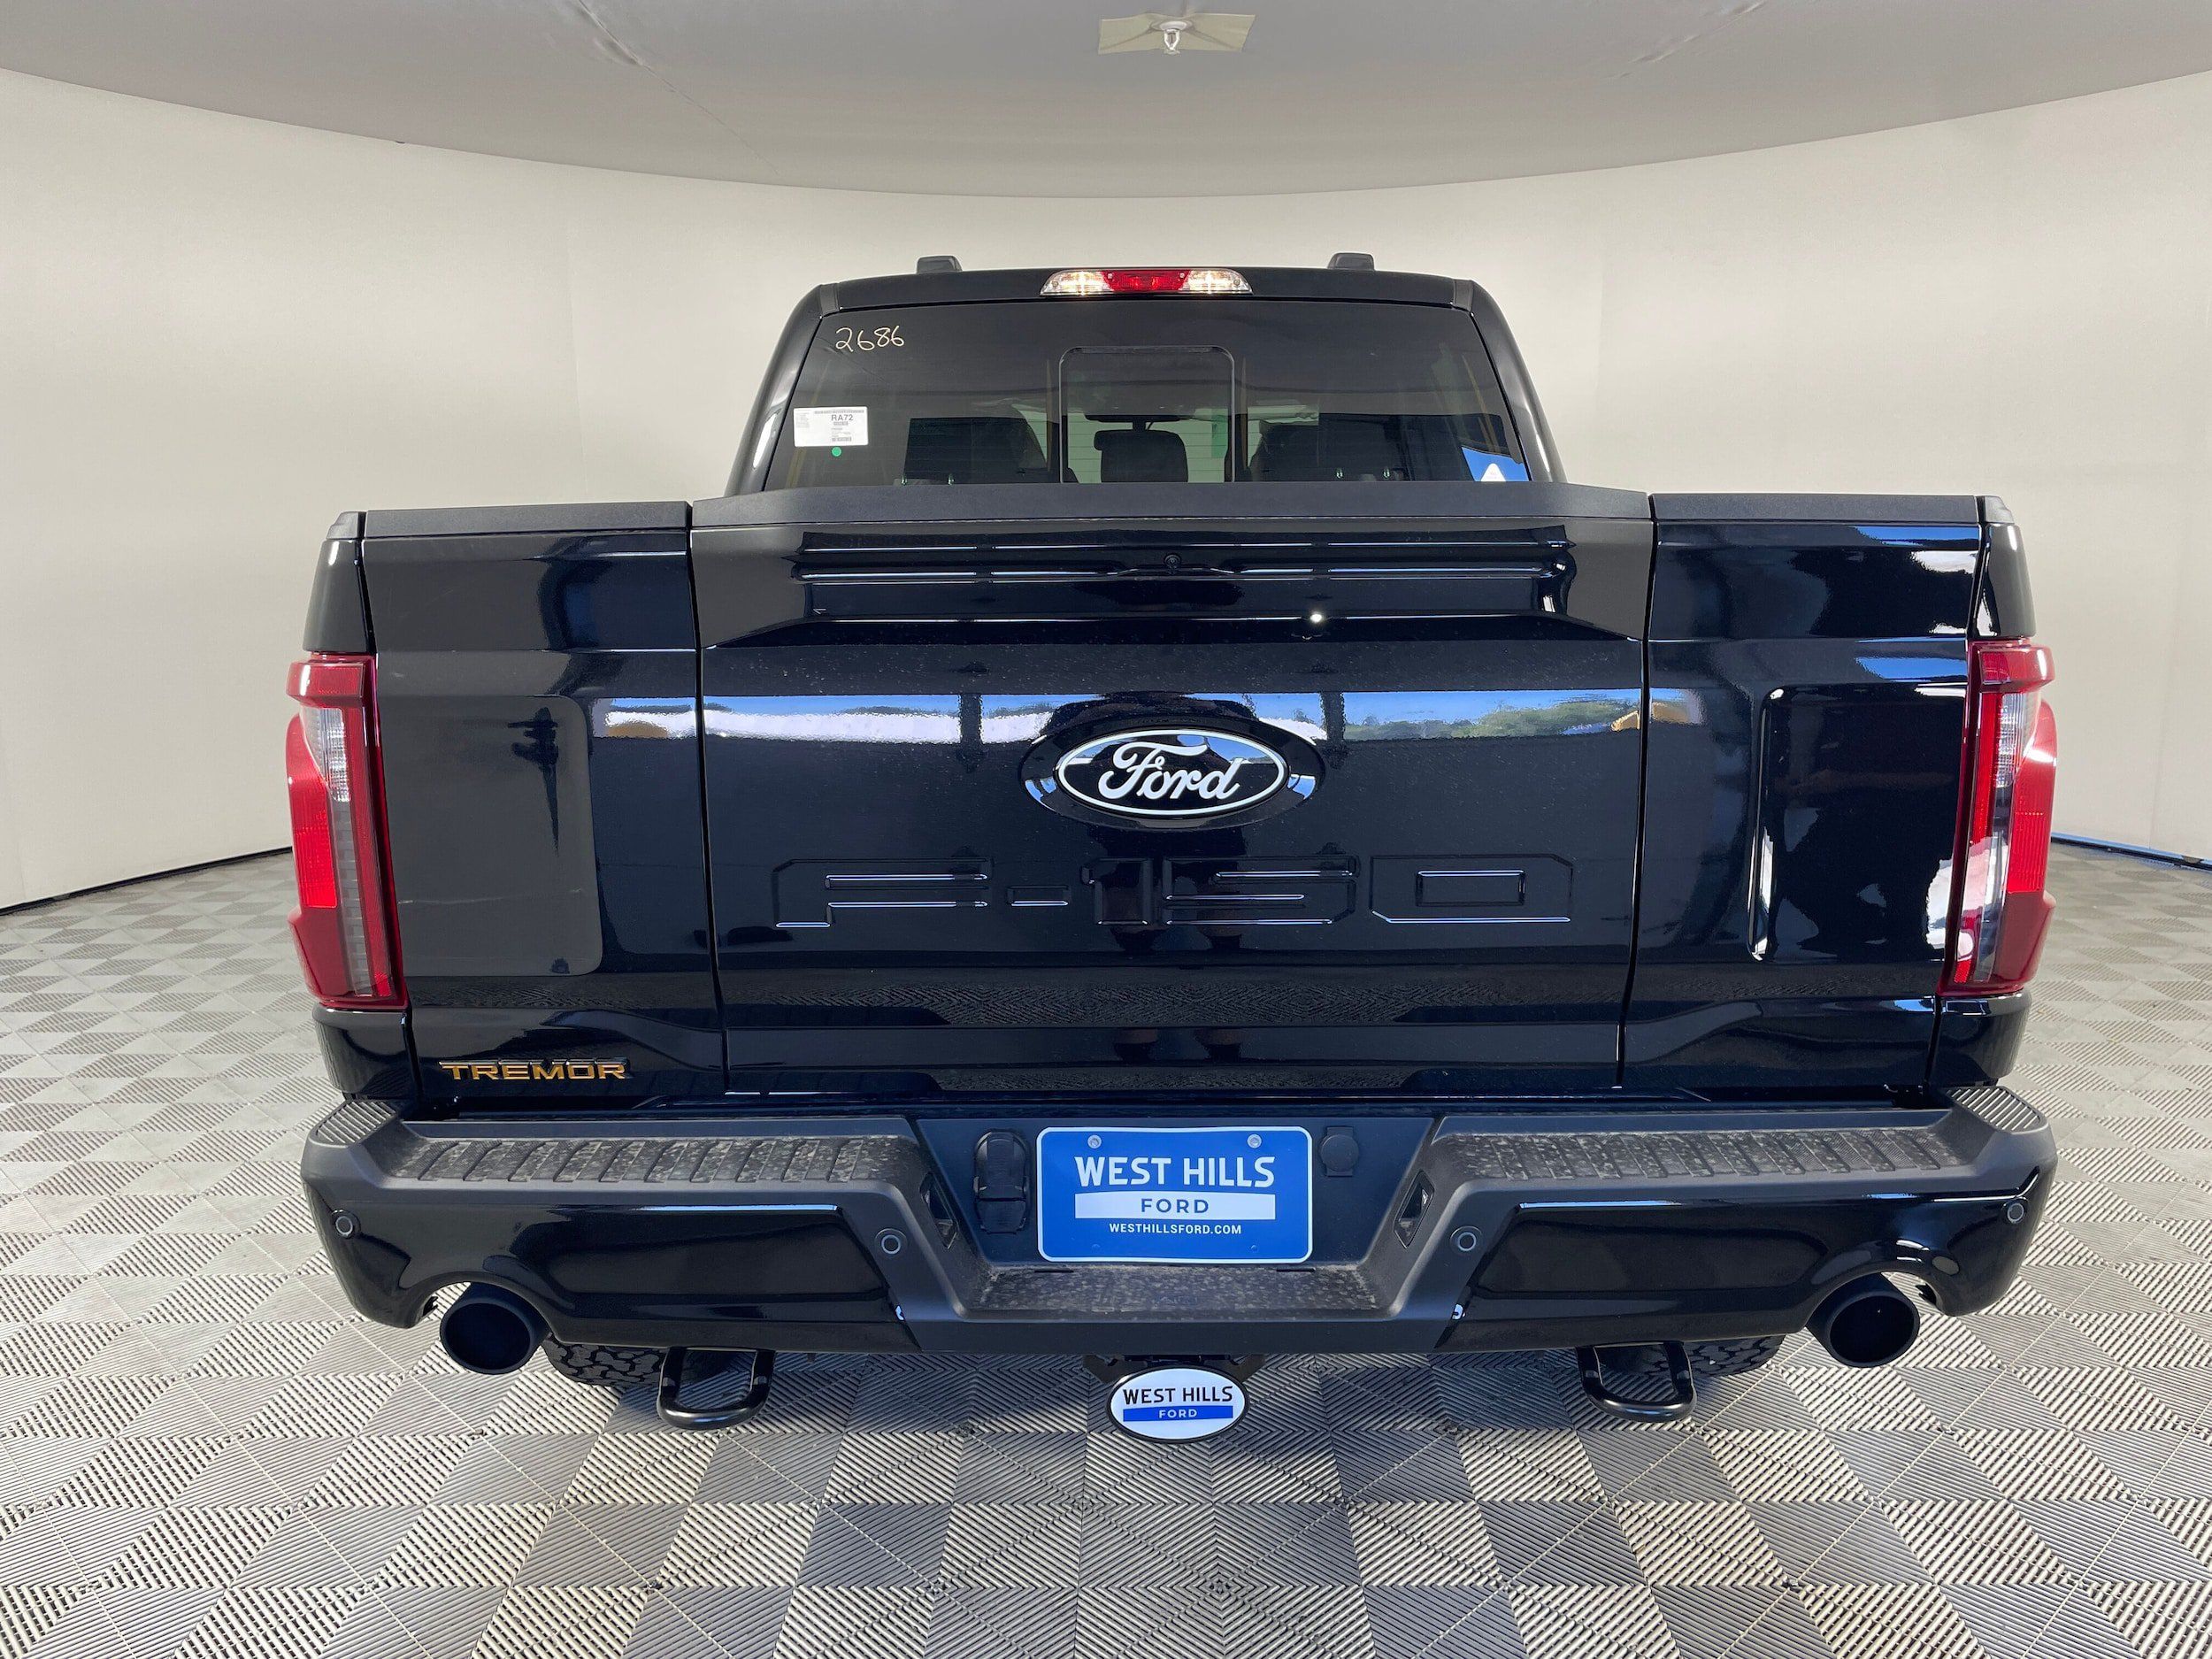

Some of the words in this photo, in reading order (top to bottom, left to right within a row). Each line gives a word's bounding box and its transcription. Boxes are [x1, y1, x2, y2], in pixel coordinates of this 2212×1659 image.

[835, 326, 904, 352] 2686
[1097, 741, 1243, 799] Ford
[772, 854, 1572, 926] F-150
[441, 1059, 630, 1080] TREMOR
[1074, 1156, 1171, 1187] WEST
[1183, 1156, 1275, 1187] HILLS
[1141, 1198, 1210, 1214] FORD
[1109, 1223, 1241, 1234] WESTHILLSFORD.COM
[1123, 1388, 1176, 1405] WEST
[1182, 1386, 1233, 1402] HILLS
[1158, 1409, 1197, 1418] FORD
